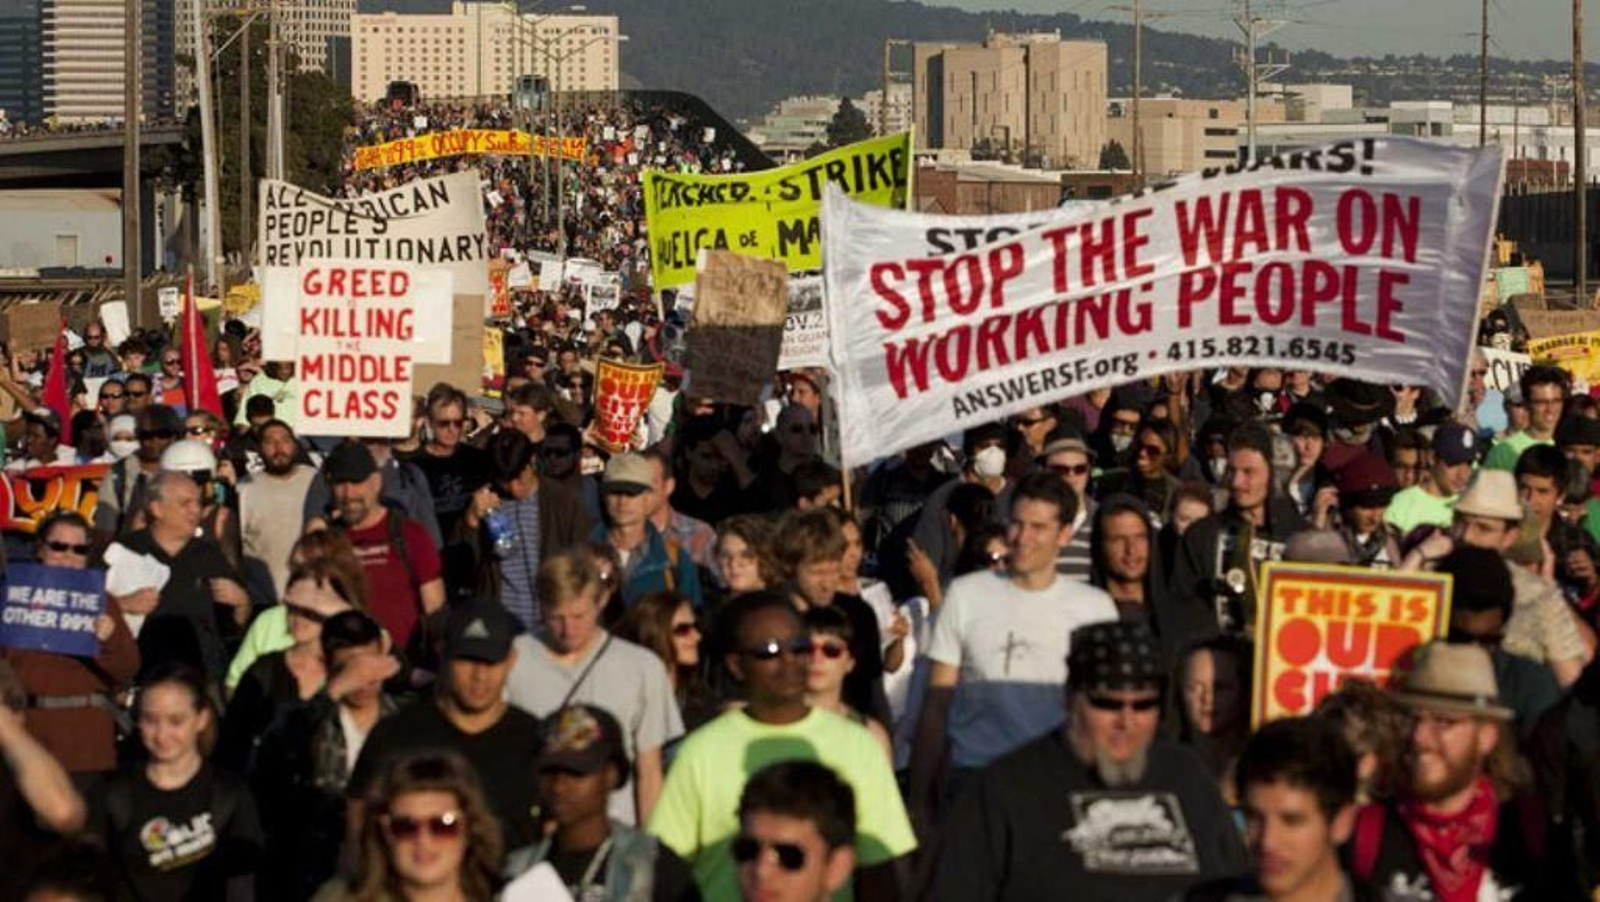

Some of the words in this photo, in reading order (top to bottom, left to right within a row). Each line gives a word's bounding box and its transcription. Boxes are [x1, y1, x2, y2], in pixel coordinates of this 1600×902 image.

[778, 147, 906, 202] STRIKE
[926, 223, 1040, 257] STO
[1203, 139, 1375, 179] ARS!
[739, 231, 758, 248] DE
[869, 242, 1025, 331] STOP
[1041, 208, 1155, 294] THE
[1175, 186, 1314, 267] WAR
[1336, 188, 1421, 264] ON
[303, 268, 410, 297] GREED
[300, 308, 414, 340] KILLING
[883, 280, 1154, 400] WORKING
[1178, 259, 1410, 343] PEOPLE
[301, 354, 411, 383] MIDDLE
[952, 352, 1140, 420] ANSWERSF.org
[1166, 336, 1356, 366] 415.821.6545
[303, 390, 400, 420] CLASS
[8, 586, 31, 603] WE
[31, 588, 68, 607] ARE
[70, 592, 100, 611] THE
[1277, 587, 1377, 617] THIS
[1388, 595, 1430, 622] IS
[3, 606, 57, 629] OTHER
[1276, 617, 1423, 670] OUR
